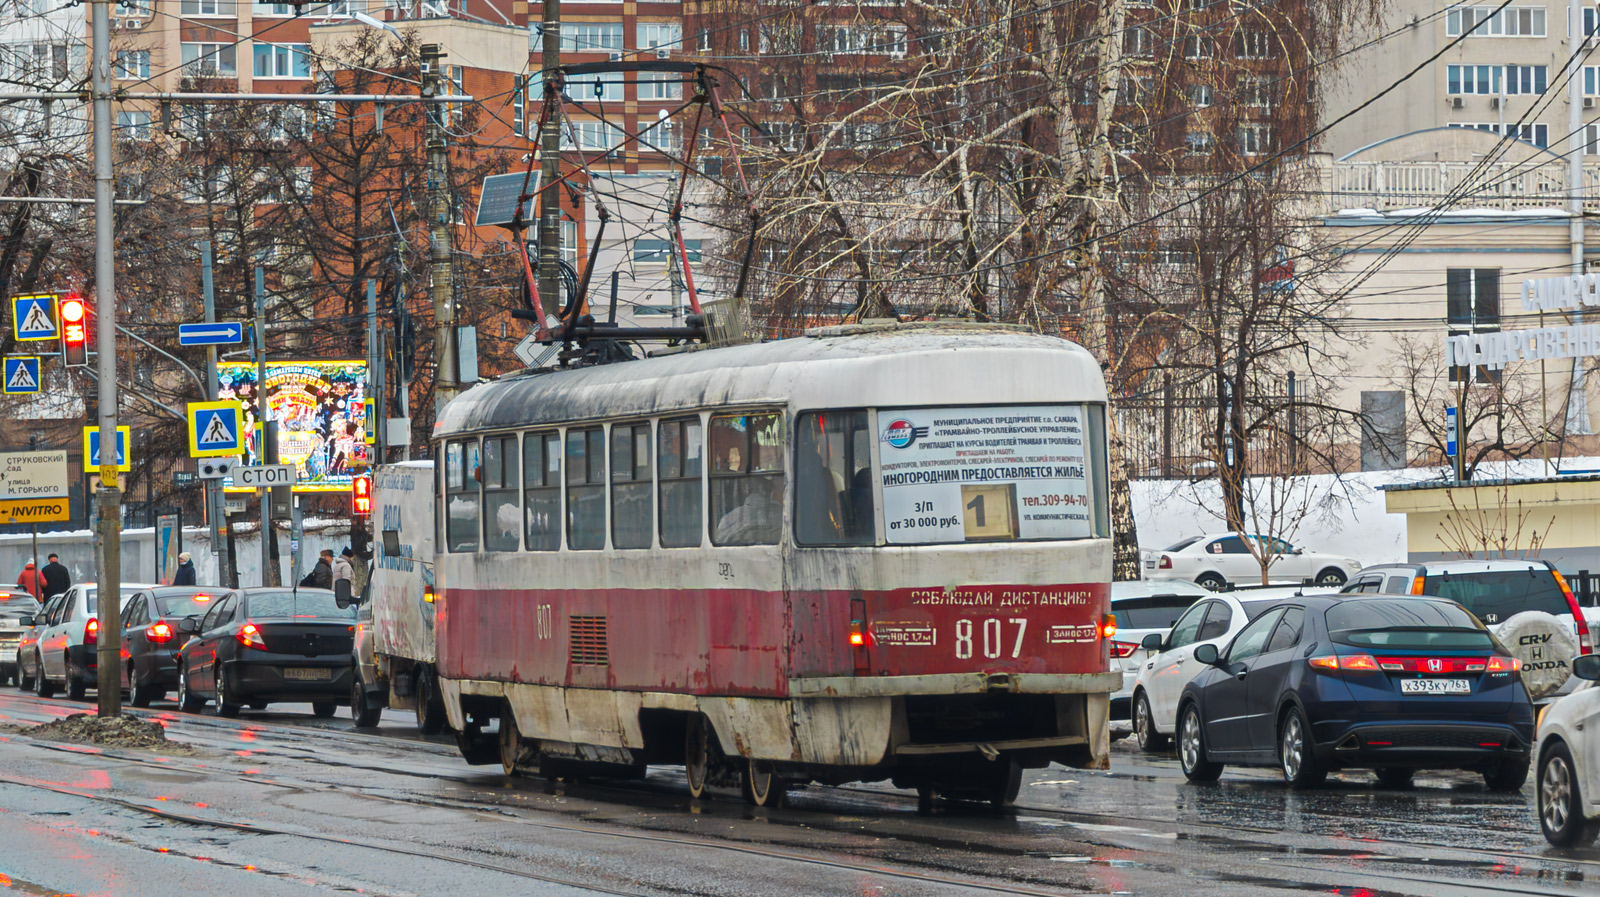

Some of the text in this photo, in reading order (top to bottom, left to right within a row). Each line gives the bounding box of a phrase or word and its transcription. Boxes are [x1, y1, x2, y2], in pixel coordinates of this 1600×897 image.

[265, 373, 331, 393] ОВОГОДНЕЕ
[934, 417, 993, 427] МУНИЦИПАЛЬНОЕ
[995, 416, 1042, 424] ПРЕДПРИЯТИЕ
[935, 425, 1037, 436] «ТРАМВАЙНО-ТРОЛЛЕЙБУСНОЕ
[919, 441, 955, 450] ПРИГЛАШАЕТ
[965, 440, 984, 448] КУРСЫ
[985, 437, 1016, 447] ВОДИТЕЛЕЙ
[1018, 438, 1042, 446] ТРАМВАЯ
[7, 454, 64, 465] СТРУКОВСКИЙ
[242, 468, 288, 483] СТОП
[883, 464, 1085, 486] ИНОГОРОДНИМ ПРЕДОСТАВЛЯЕТСЯ ЖИЛЬЁ
[8, 485, 59, 495] М. ГОРЬКОГО
[1022, 493, 1087, 507] тел.309-94-70
[11, 504, 62, 516] INVITRO
[966, 494, 986, 527] 1
[890, 515, 960, 529] от 30 000 руб.
[912, 590, 1092, 607] СОБЛЮДАЙ ДИСТАНЦИЮ!
[537, 604, 551, 640] 807
[955, 617, 1028, 660] 807
[1053, 630, 1082, 638] ЗАНОС
[1519, 633, 1553, 646] CR-V
[1521, 660, 1568, 672] ONDA
[1450, 680, 1467, 689] 763
